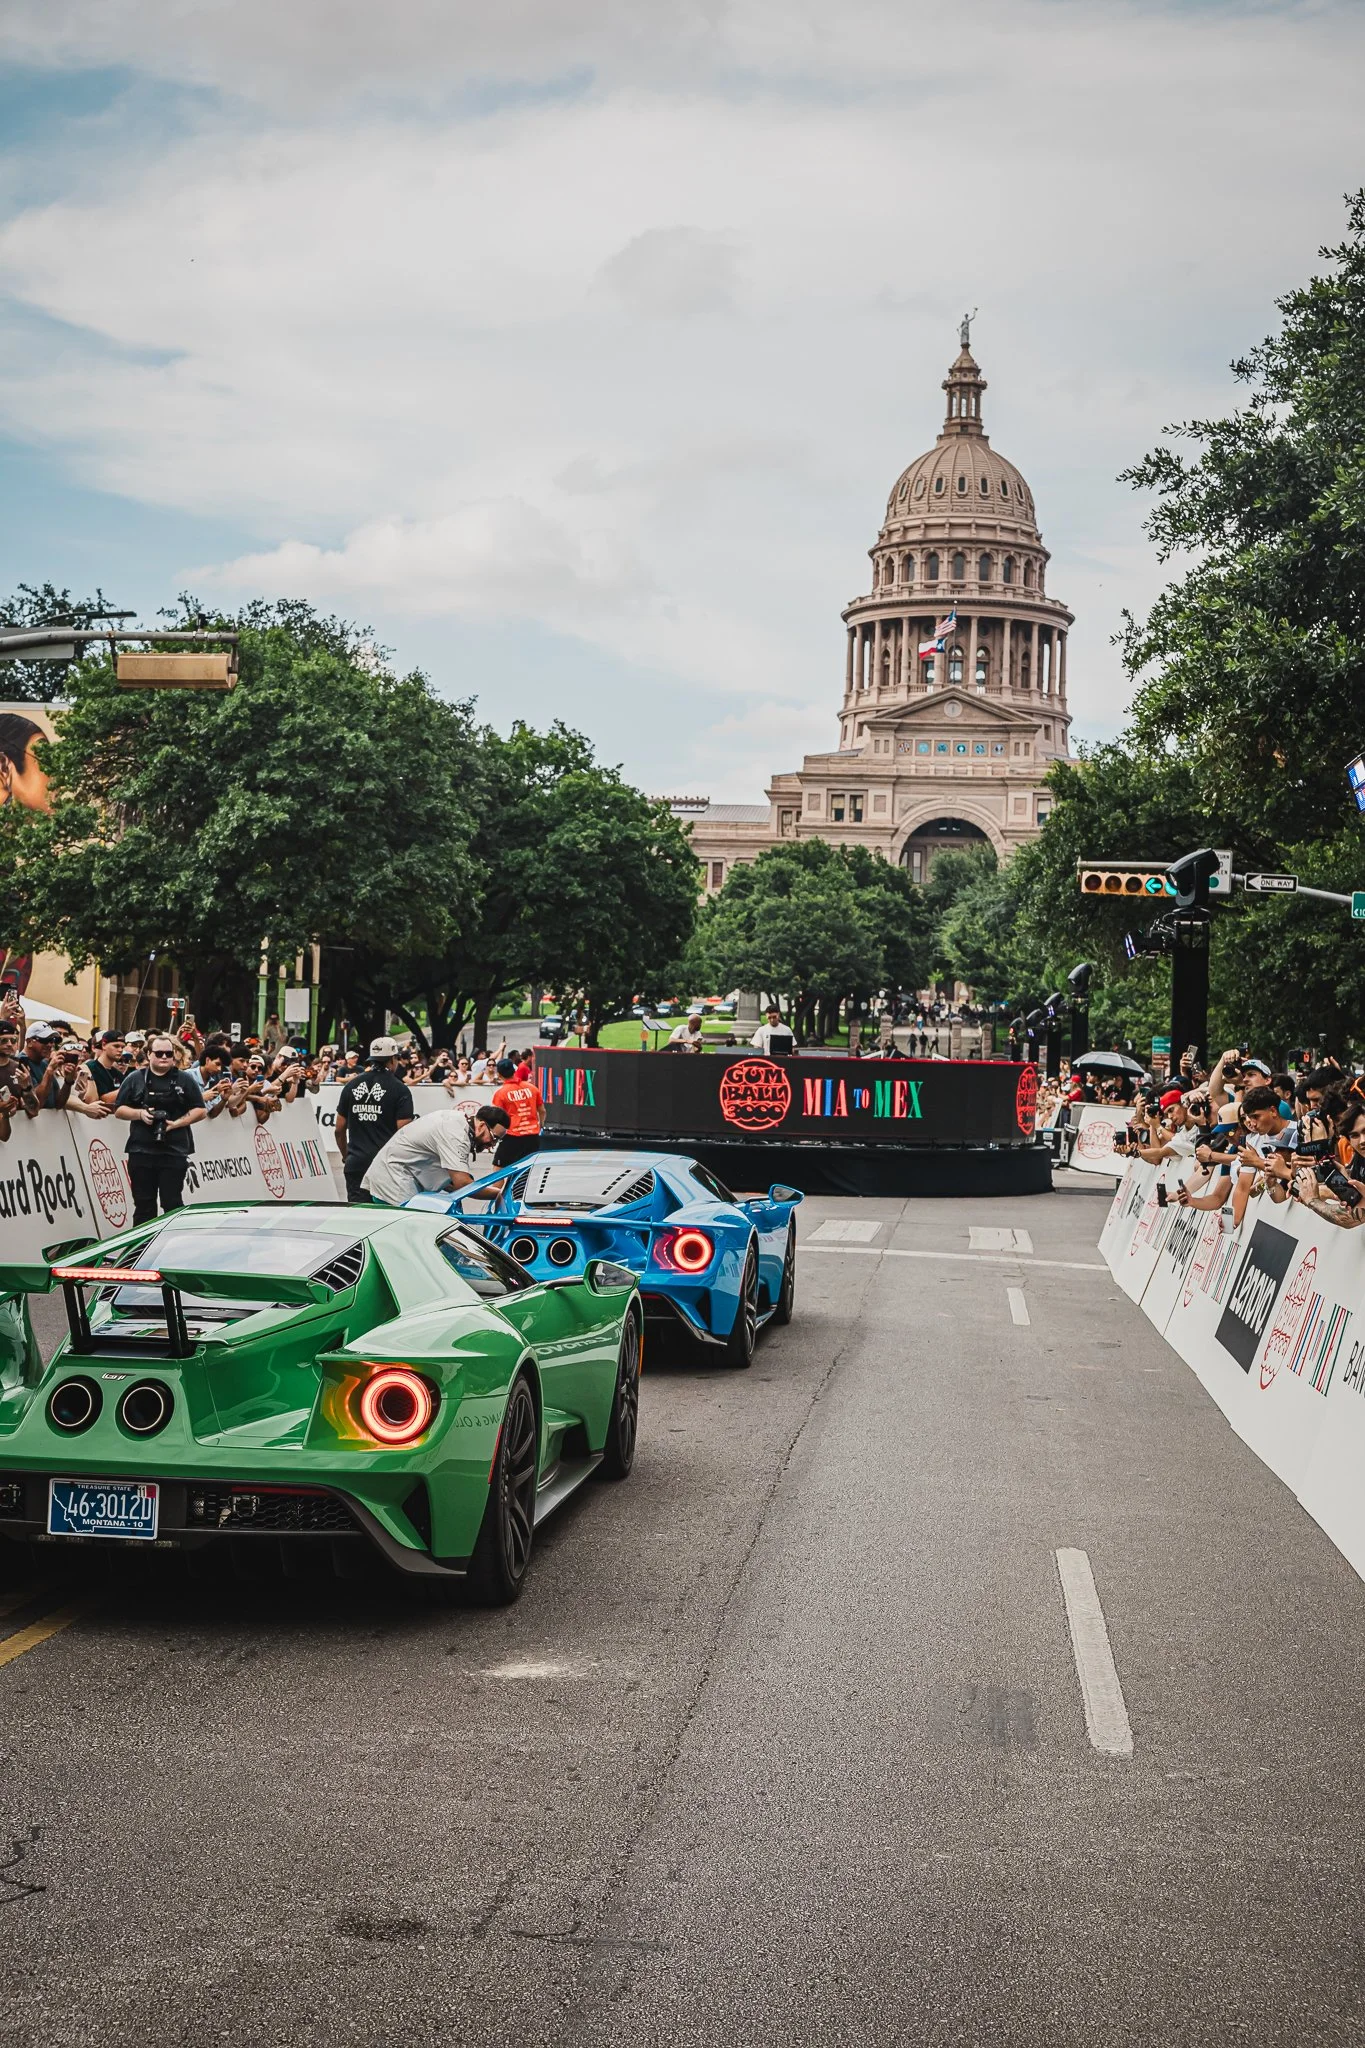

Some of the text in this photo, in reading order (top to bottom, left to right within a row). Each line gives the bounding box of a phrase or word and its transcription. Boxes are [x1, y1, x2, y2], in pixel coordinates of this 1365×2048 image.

[1260, 879, 1275, 887] ONE
[725, 1065, 785, 1085] GUM
[507, 1088, 533, 1101] CREW
[563, 1068, 597, 1107] MEX
[722, 1084, 787, 1103] BALL
[802, 1078, 923, 1118] MIA TO MEX
[352, 1104, 383, 1115] GUMBALL
[358, 1112, 378, 1122] 3000
[199, 1156, 252, 1181] AEROMEXICO
[0, 1156, 82, 1224] ard Rock
[1228, 1247, 1277, 1335] Lenovo
[1343, 1340, 1365, 1399] BAN
[67, 1491, 152, 1520] 46 3012D
[82, 1519, 126, 1527] MONTANA
